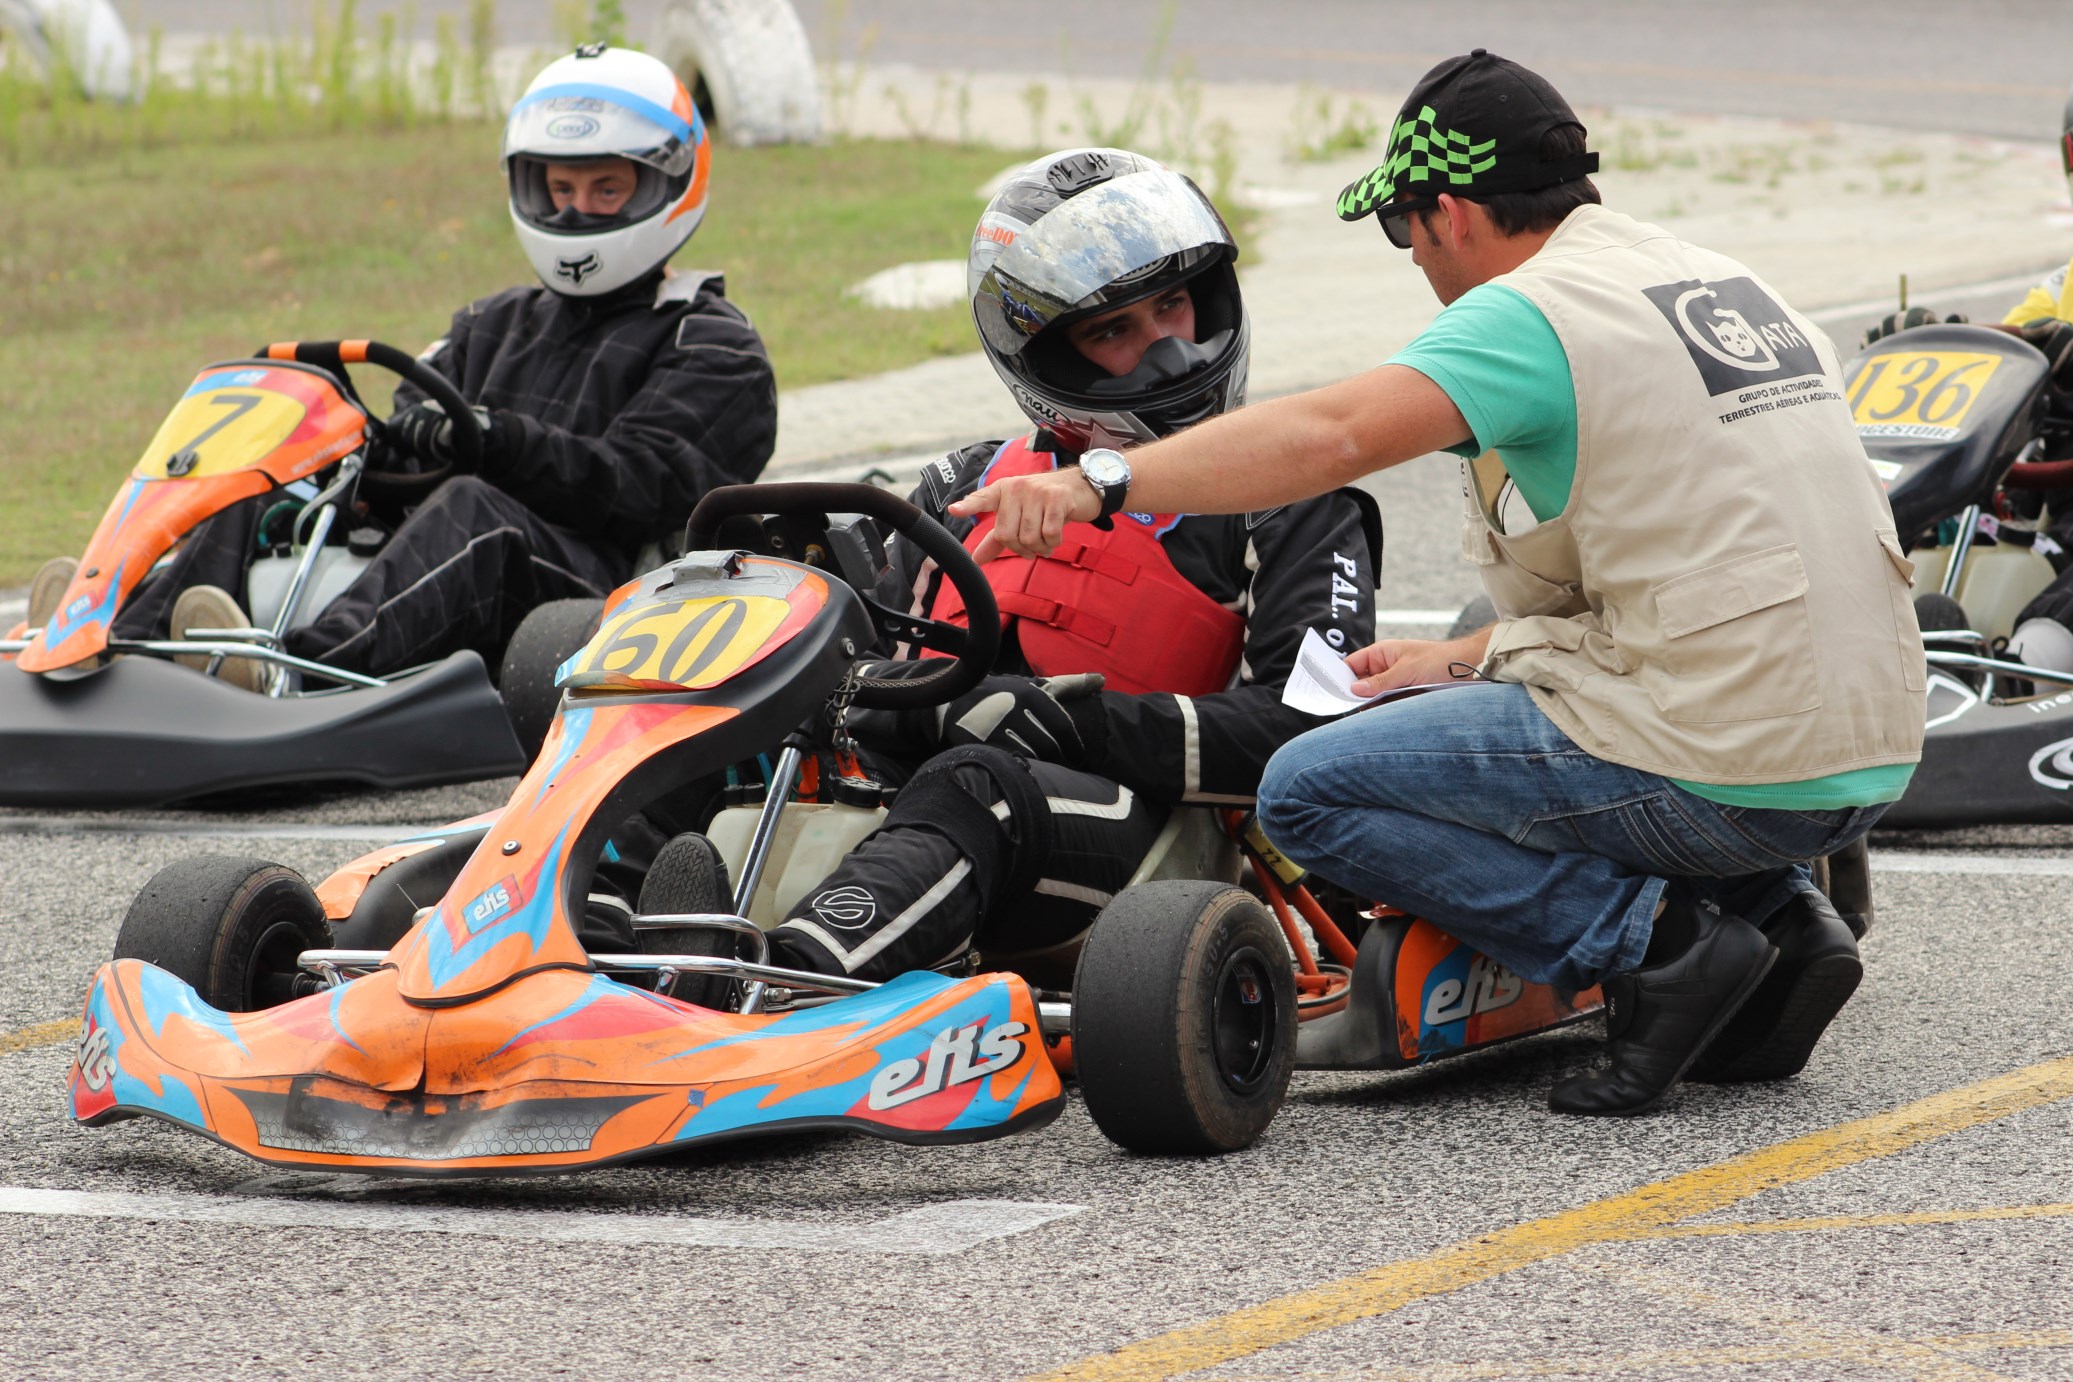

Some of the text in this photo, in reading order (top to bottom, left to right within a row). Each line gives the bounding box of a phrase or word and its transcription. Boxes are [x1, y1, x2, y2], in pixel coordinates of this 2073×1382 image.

[1718, 402, 1775, 425] TERRESTRES
[1776, 396, 1802, 410] AÉREAS
[1802, 394, 1809, 403] E
[1738, 389, 1769, 404] GRUPO
[1770, 386, 1781, 396] DE
[1854, 356, 1990, 424] 136
[178, 394, 263, 458] 7
[586, 599, 748, 685] 60
